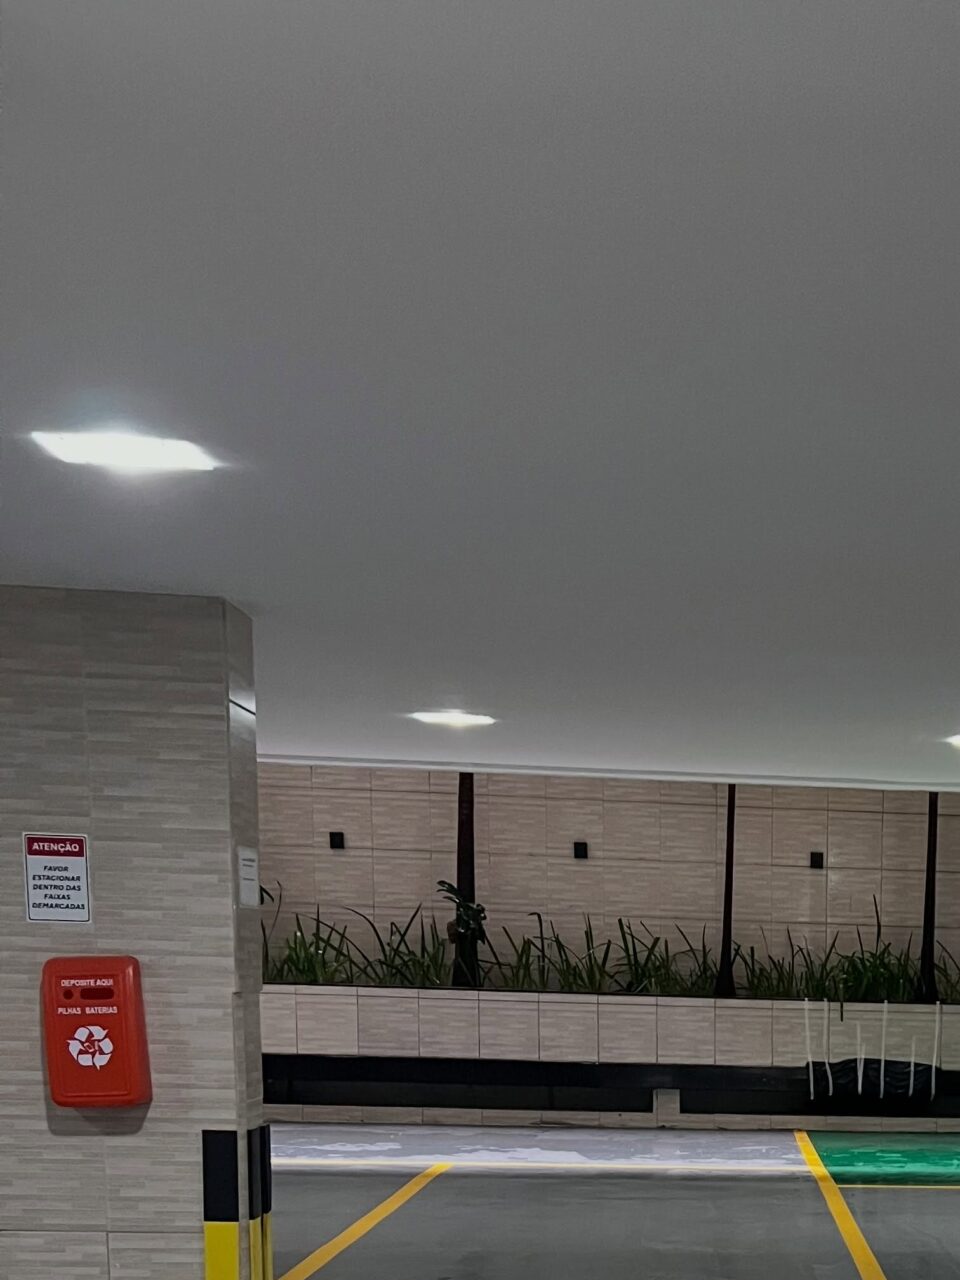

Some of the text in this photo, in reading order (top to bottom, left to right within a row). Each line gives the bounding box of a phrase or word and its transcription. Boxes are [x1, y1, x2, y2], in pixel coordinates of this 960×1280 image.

[32, 842, 79, 853] ATENÇÃO
[32, 874, 81, 882] ESTACIONAR
[32, 902, 85, 910] DEMARCADAS
[61, 979, 95, 987] DEPOSITE
[58, 1006, 118, 1015] PILHAS BATERIAS
